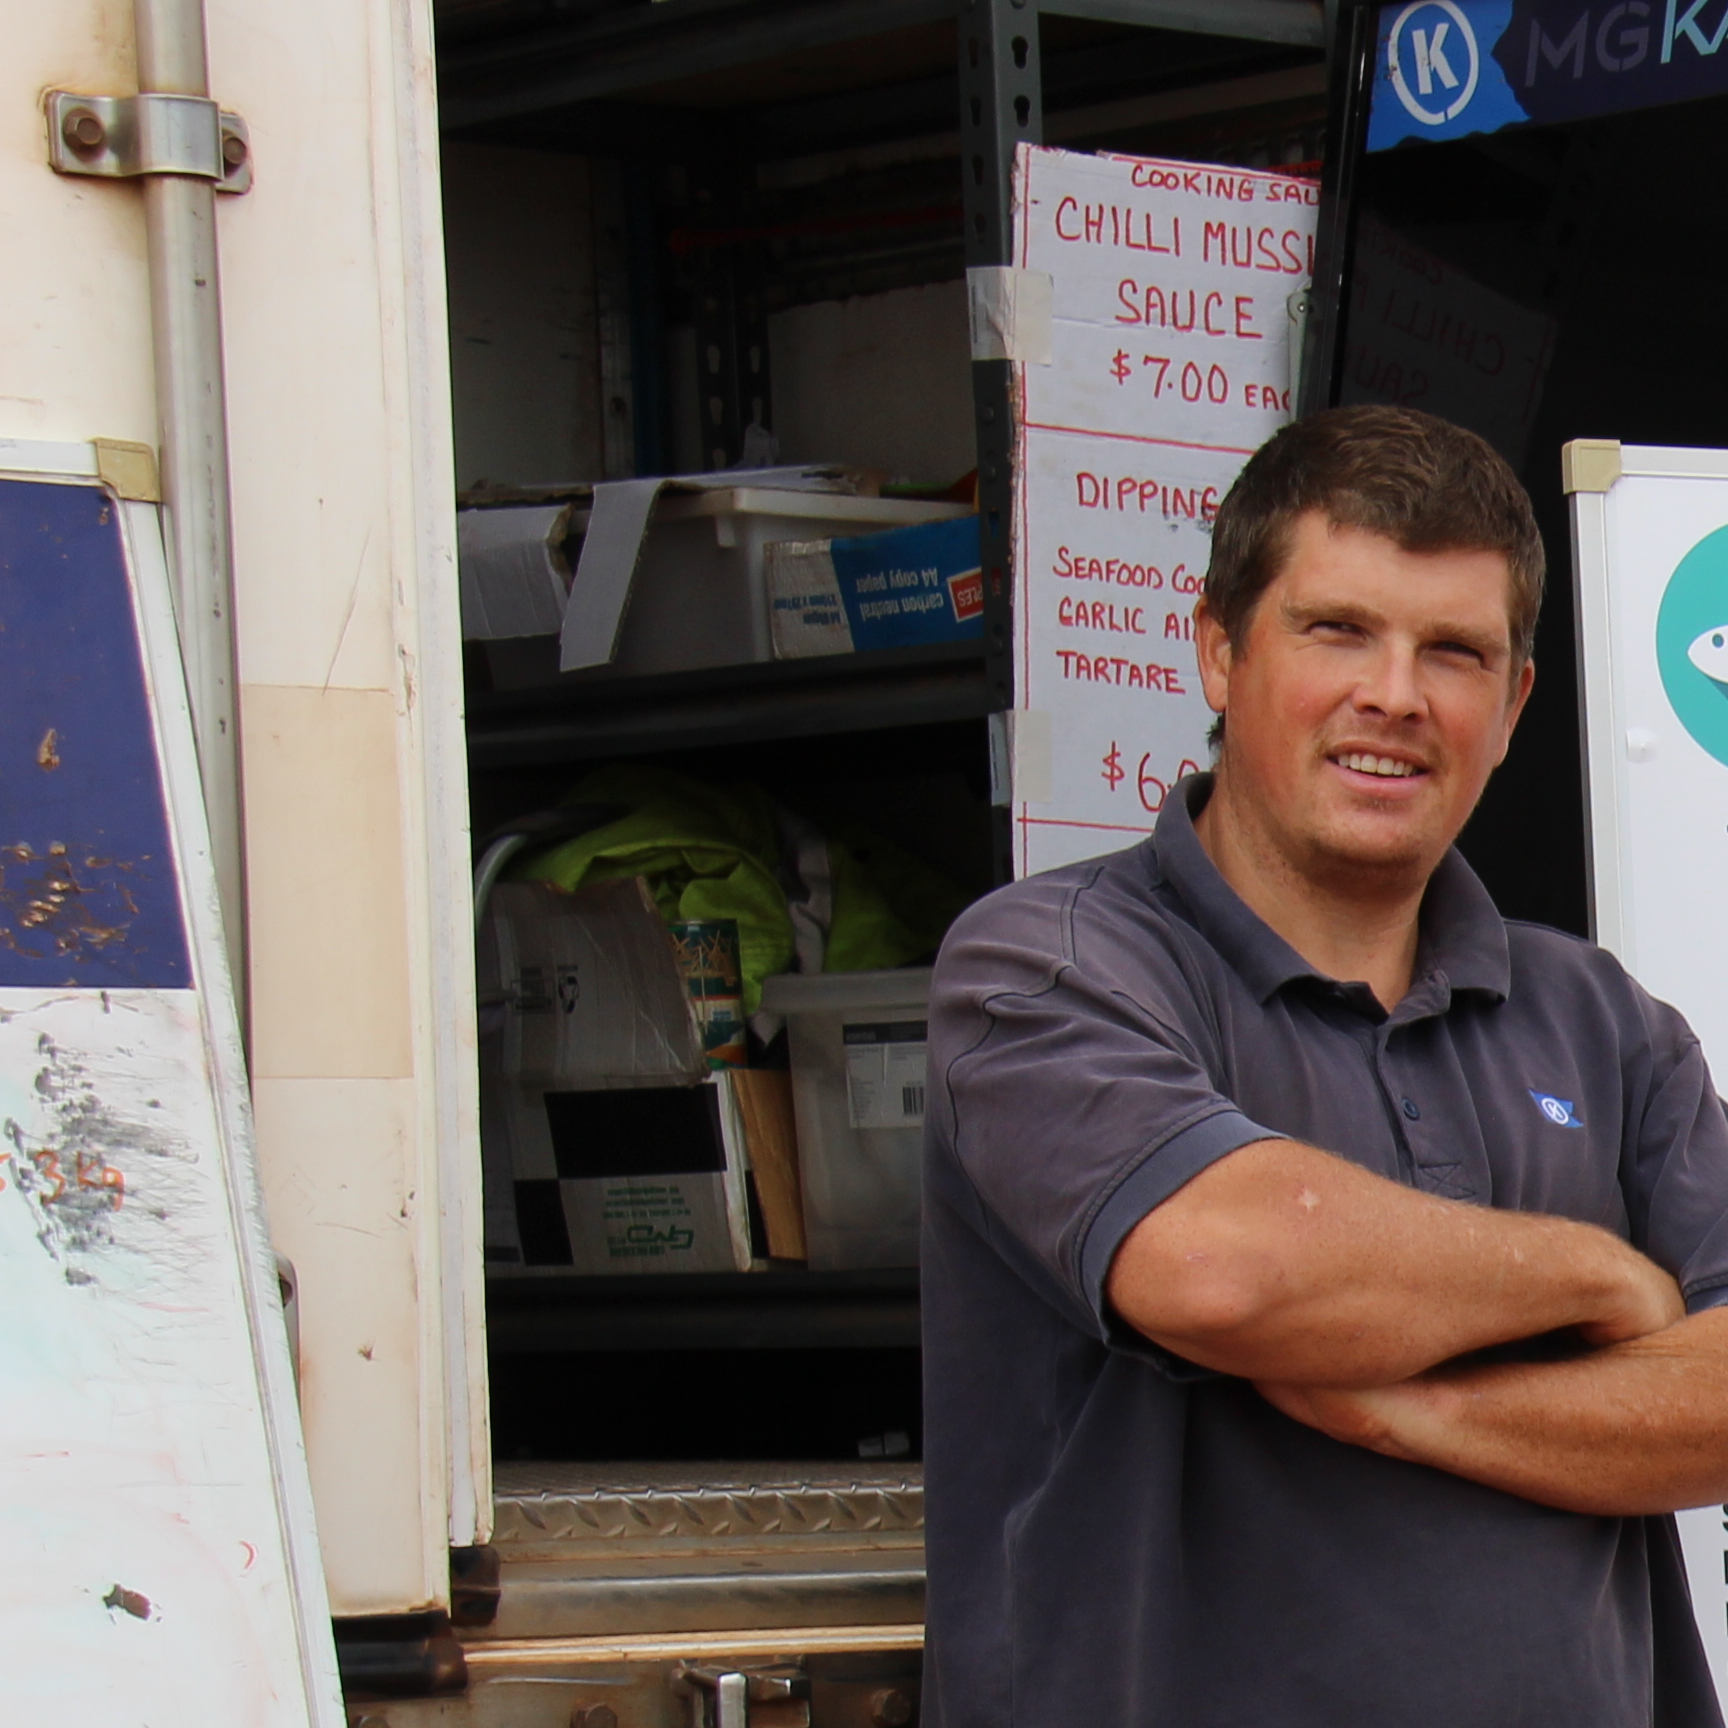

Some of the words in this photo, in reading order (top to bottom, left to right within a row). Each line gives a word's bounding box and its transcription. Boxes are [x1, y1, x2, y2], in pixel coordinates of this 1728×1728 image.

[1131, 164, 1255, 203] COOKING
[1264, 182, 1321, 206] SAU
[1055, 196, 1182, 257] CHILLI
[1115, 278, 1264, 340] SAUCE
[1076, 471, 1221, 522] DIPPING
[1053, 546, 1165, 590] SEAFOOD
[859, 601, 899, 622] neutral
[900, 592, 945, 614] carbon
[1058, 596, 1147, 635] GARLIC
[1056, 650, 1186, 695] TARTARE
